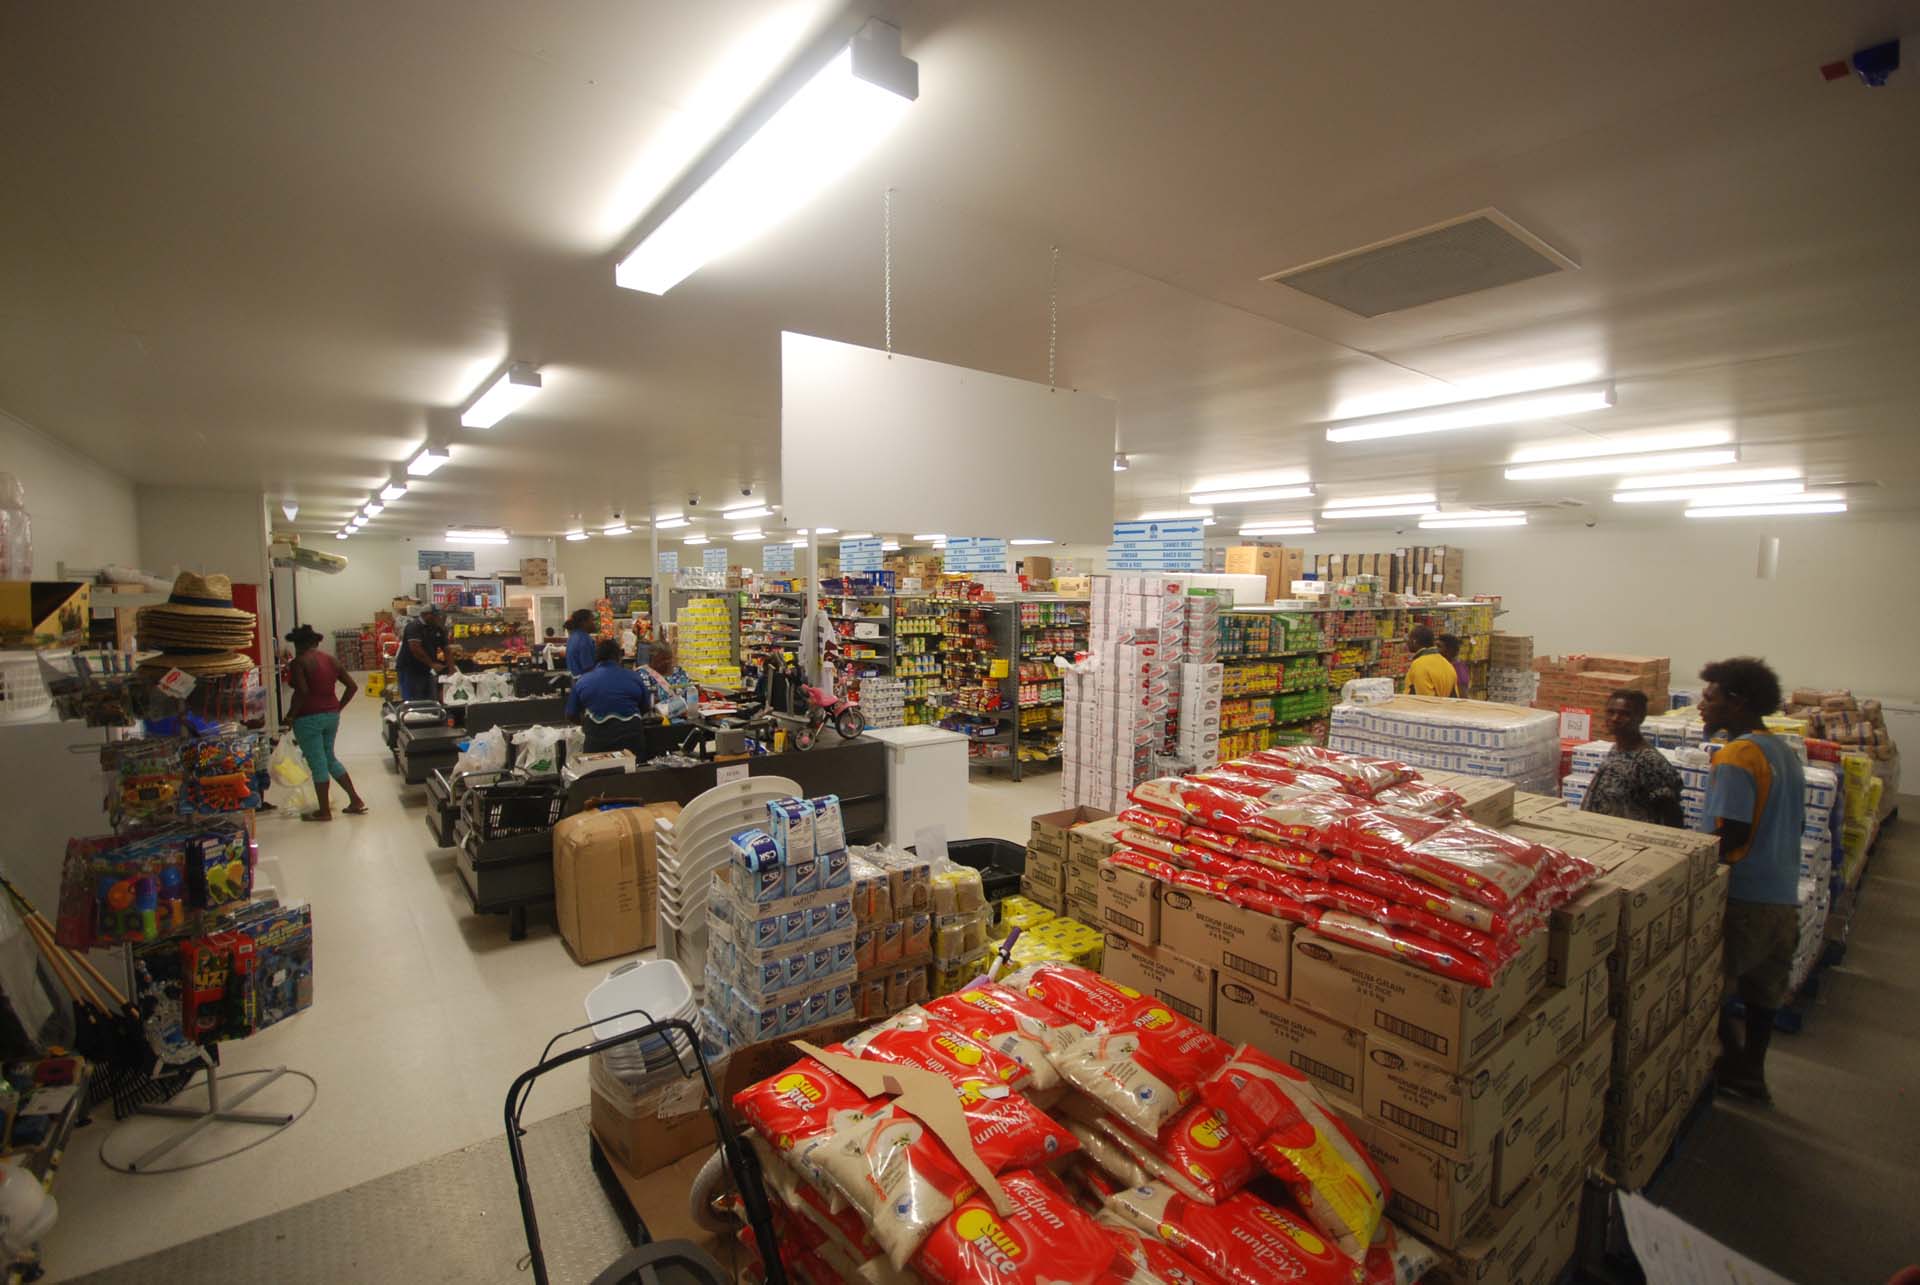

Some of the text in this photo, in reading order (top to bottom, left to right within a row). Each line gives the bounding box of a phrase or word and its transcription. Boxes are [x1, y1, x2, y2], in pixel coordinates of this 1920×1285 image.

[759, 850, 777, 862] CSR
[831, 857, 847, 867] CSR
[762, 871, 779, 881] CSR
[797, 865, 813, 875] CSR
[798, 1080, 822, 1102] Sun
[1008, 1179, 1065, 1230] Medium
[984, 1222, 1022, 1257] Sun
[1231, 1226, 1301, 1279] Medium
